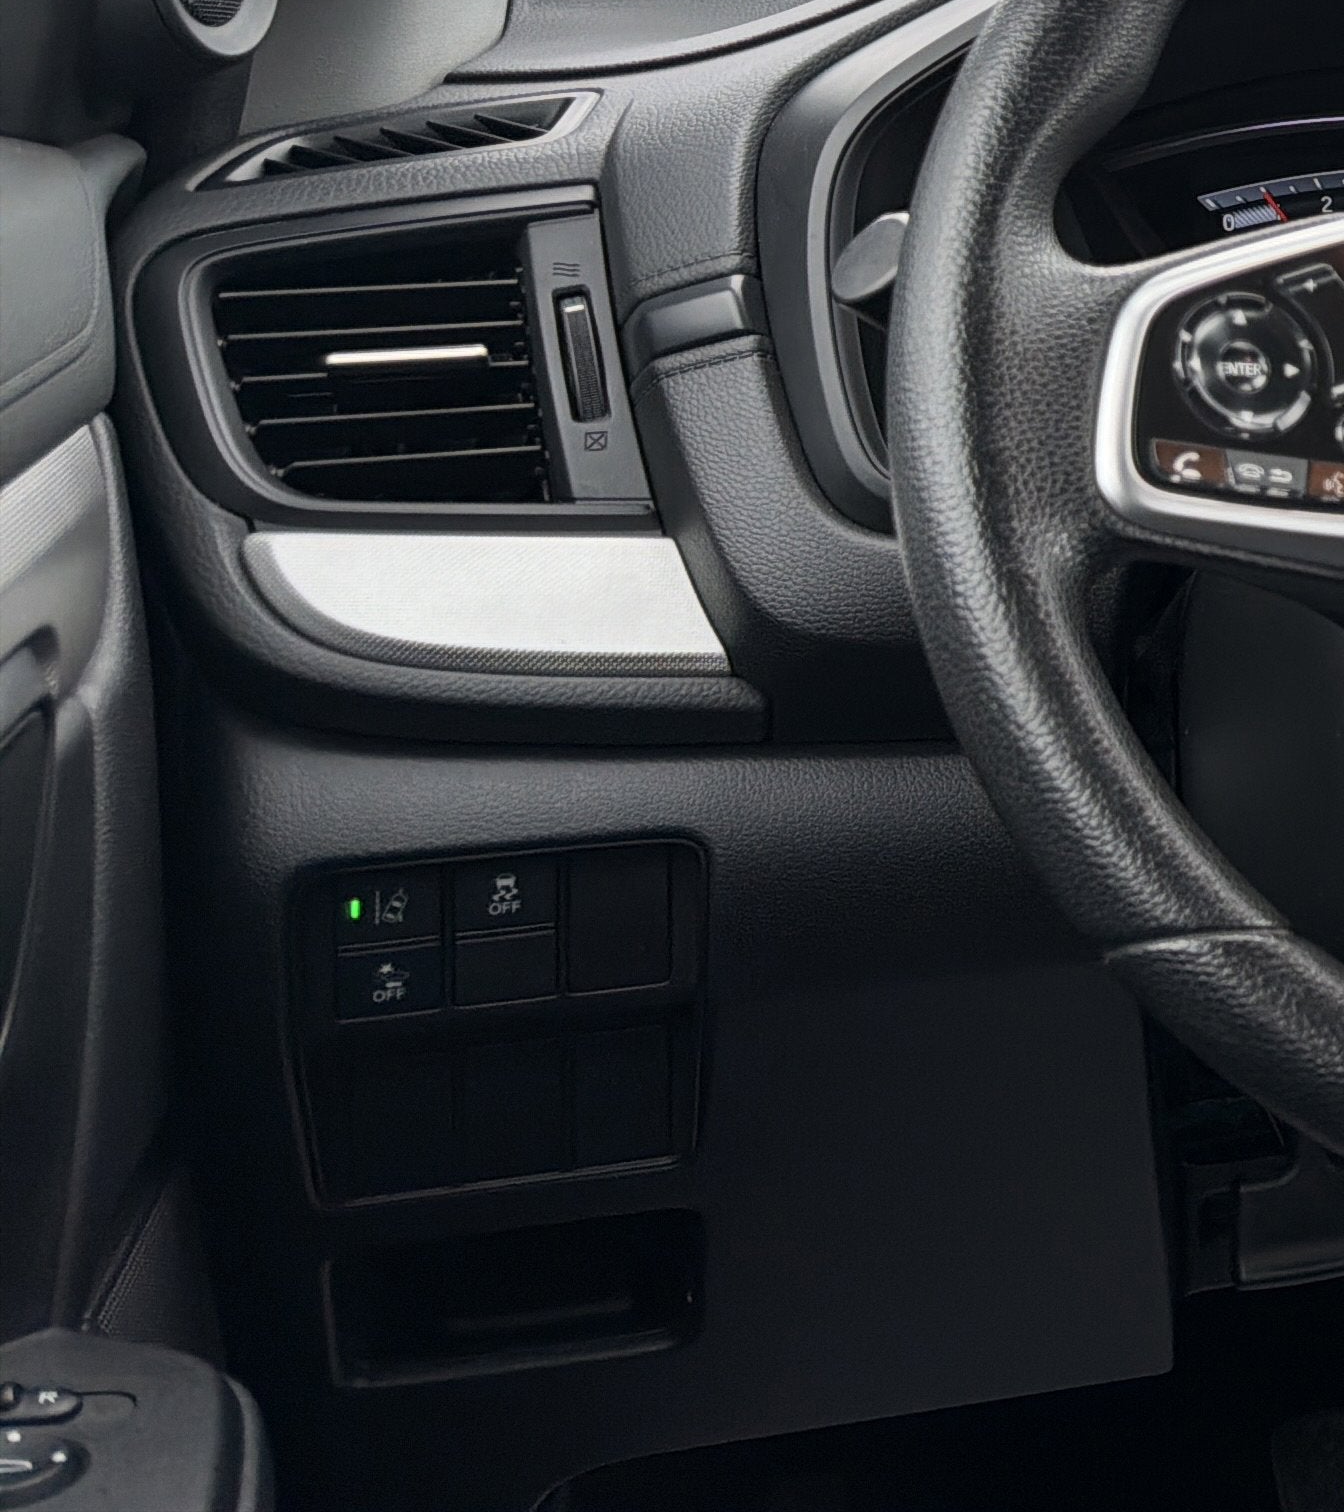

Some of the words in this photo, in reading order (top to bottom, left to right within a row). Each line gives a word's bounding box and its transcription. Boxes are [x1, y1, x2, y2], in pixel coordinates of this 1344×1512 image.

[1320, 196, 1334, 213] 2
[488, 899, 522, 916] OFF
[372, 987, 407, 1004] OFF
